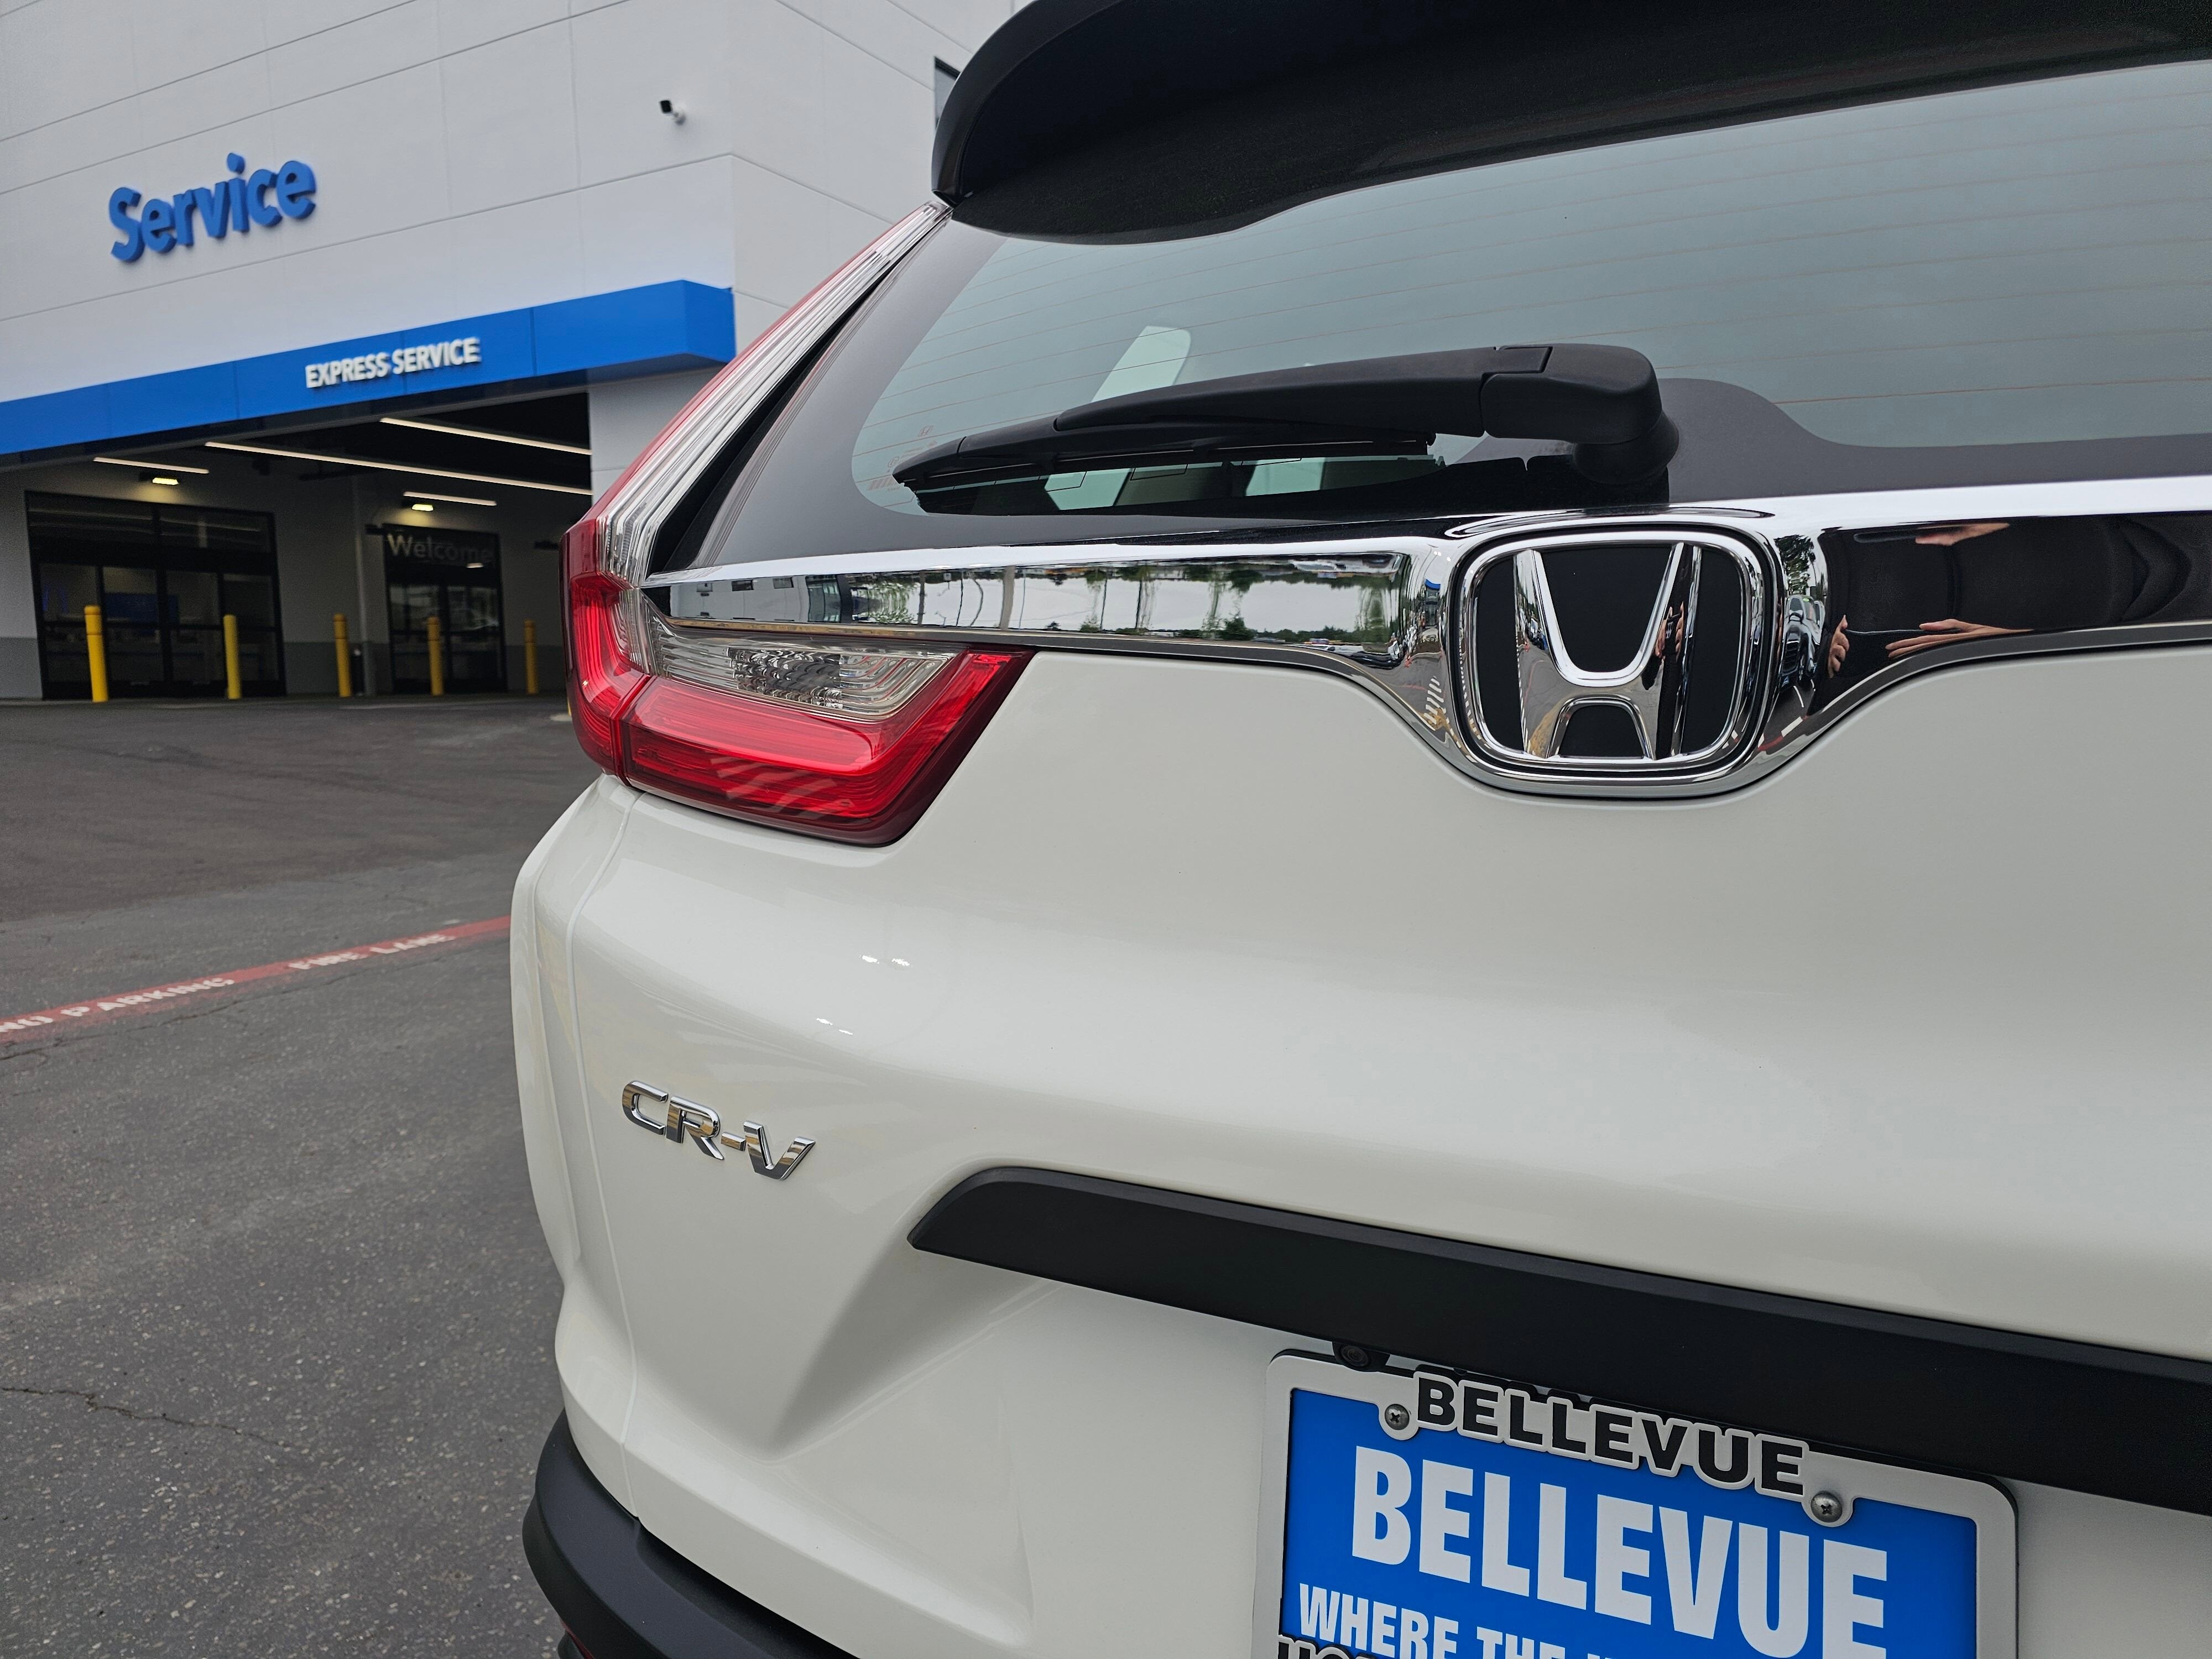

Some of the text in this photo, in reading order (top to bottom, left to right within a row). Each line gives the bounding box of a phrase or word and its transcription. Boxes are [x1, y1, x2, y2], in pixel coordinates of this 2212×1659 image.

[109, 153, 316, 262] Service
[305, 336, 482, 388] EXPRESS SERVICE
[388, 533, 494, 564] Welcome
[60, 978, 235, 1017] PARKING
[622, 1079, 816, 1181] CR-V
[1416, 1375, 1806, 1496] BELLEVUE
[1352, 1445, 1887, 1659] BELLEVUE
[1299, 1582, 1459, 1659] WHERE
